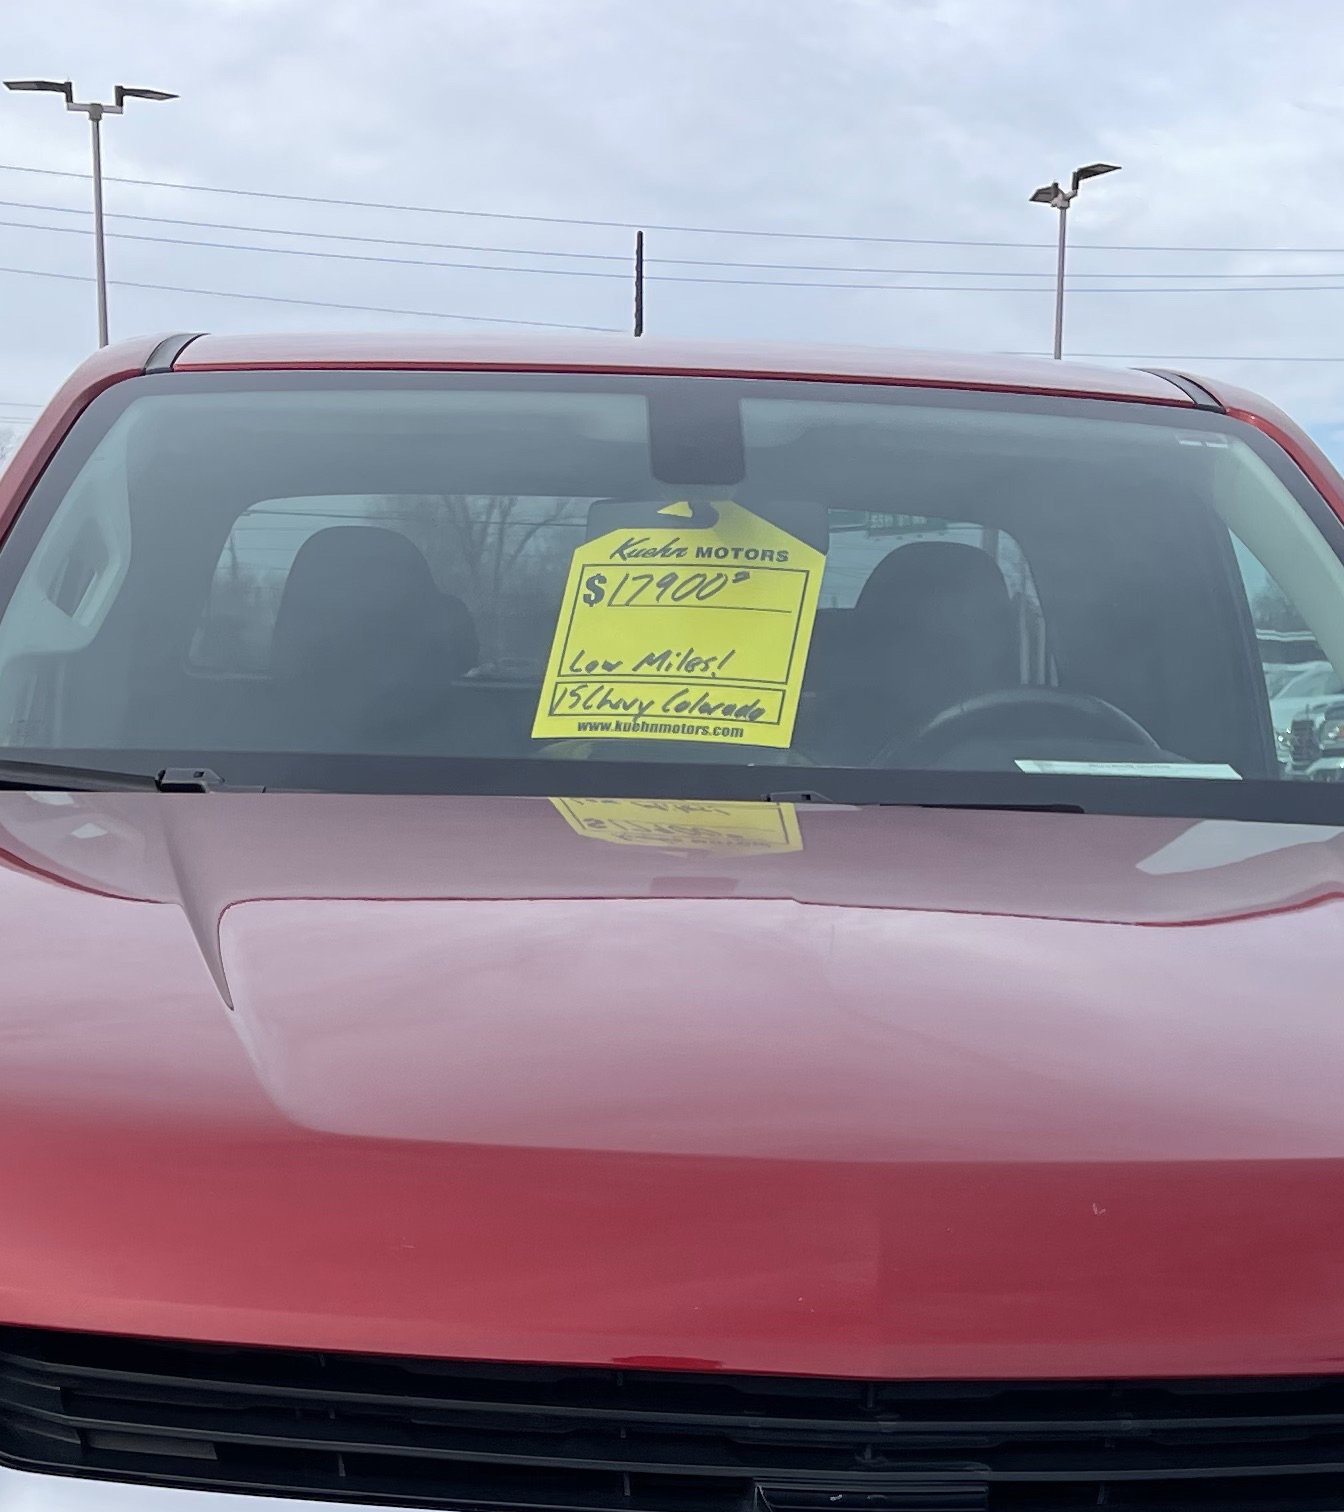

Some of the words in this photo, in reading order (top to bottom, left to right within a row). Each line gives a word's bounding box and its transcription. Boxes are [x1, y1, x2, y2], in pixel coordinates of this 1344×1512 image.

[609, 536, 689, 562] Kuehn
[695, 546, 789, 563] MOTORS
[661, 687, 766, 722] Colorado
[577, 720, 744, 738] www.kuehnmotors.com
